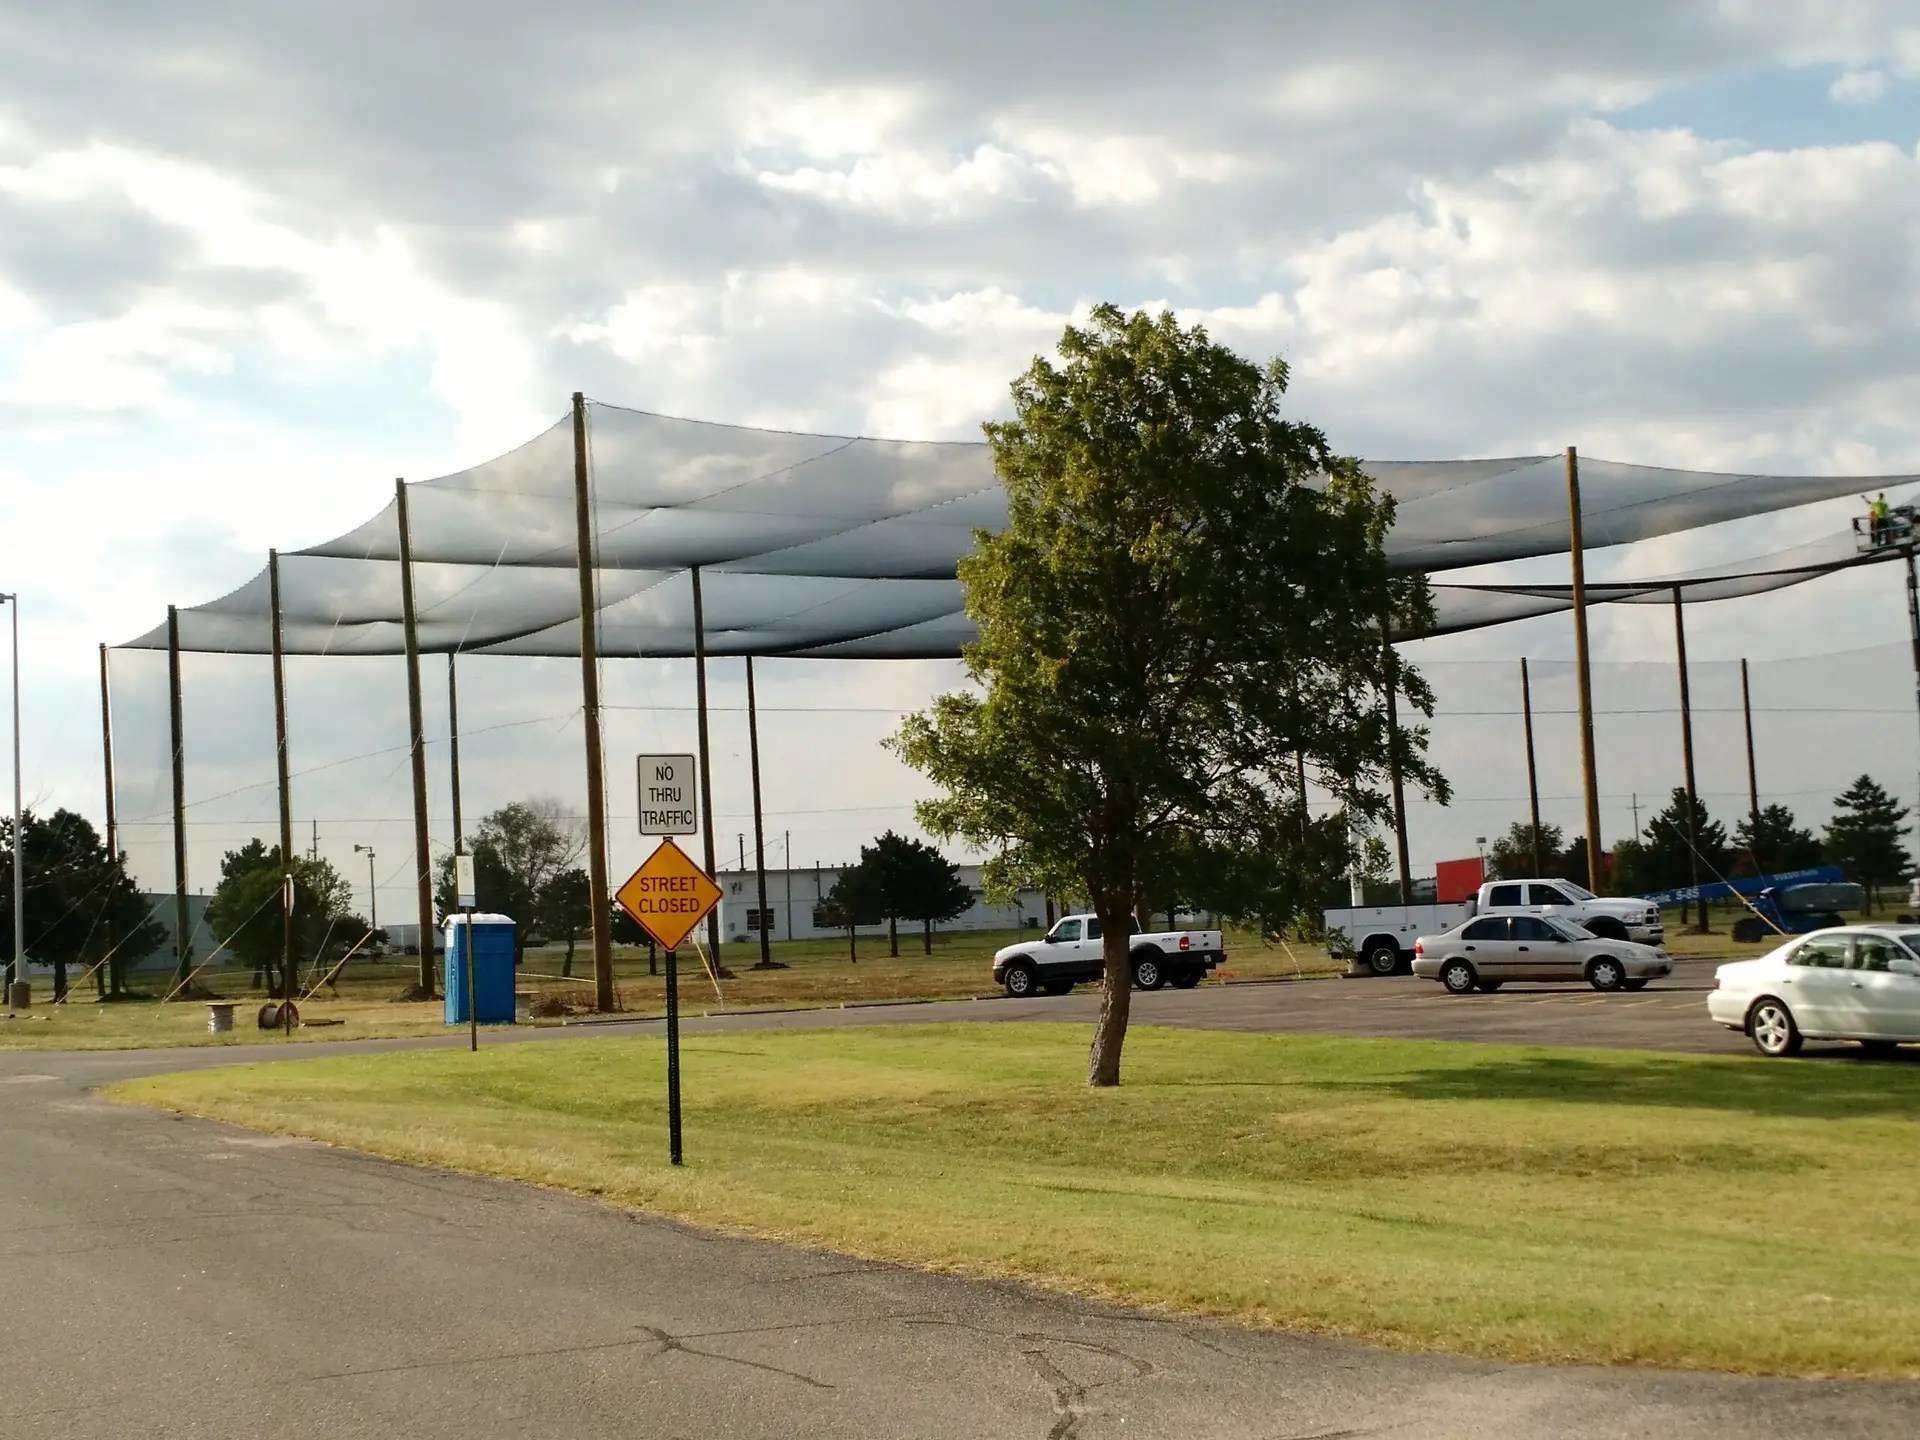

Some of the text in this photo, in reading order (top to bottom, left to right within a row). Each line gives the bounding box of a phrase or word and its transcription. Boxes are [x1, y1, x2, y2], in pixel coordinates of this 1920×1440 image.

[656, 766, 674, 781] NO
[649, 787, 681, 802] THRU
[642, 810, 693, 826] TRAFFIC
[640, 876, 698, 892] STREET
[639, 898, 700, 913] CLOSED
